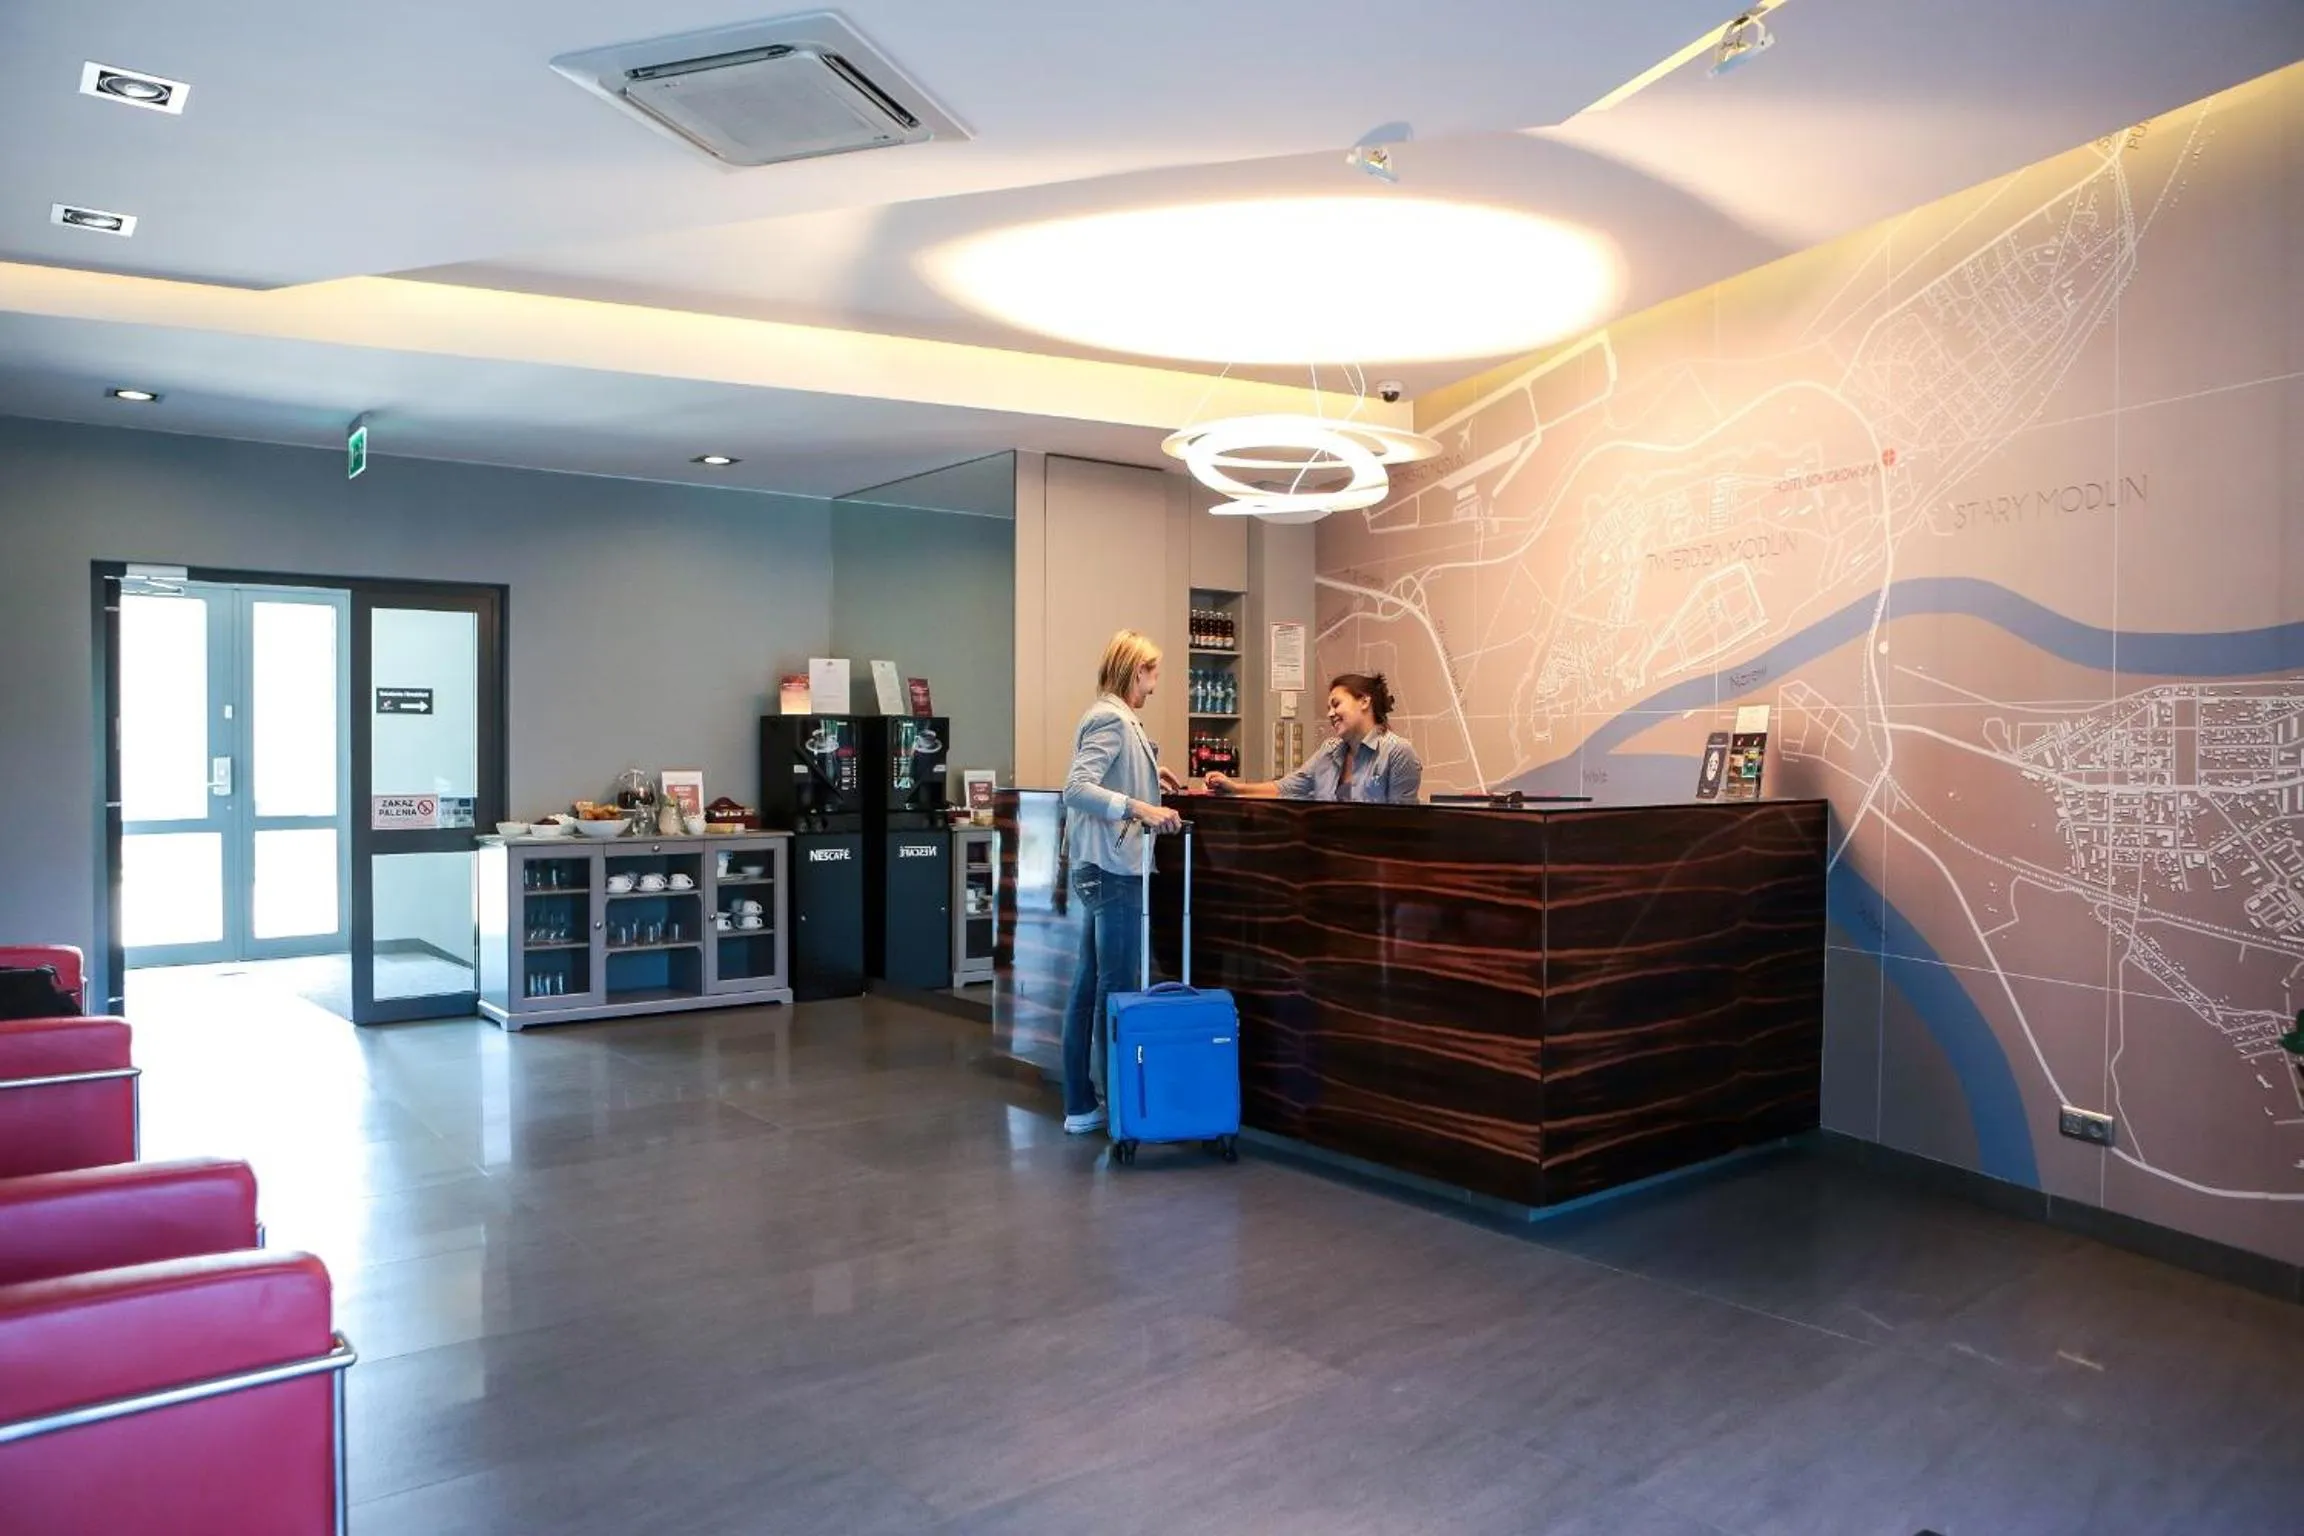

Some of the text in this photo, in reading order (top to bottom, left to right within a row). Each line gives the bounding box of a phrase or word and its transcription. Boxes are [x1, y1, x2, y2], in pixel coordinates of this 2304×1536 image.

[1953, 473, 2148, 530] STARY MODLIN
[381, 799, 414, 807] ZAKAZ
[378, 808, 417, 817] PALENIA
